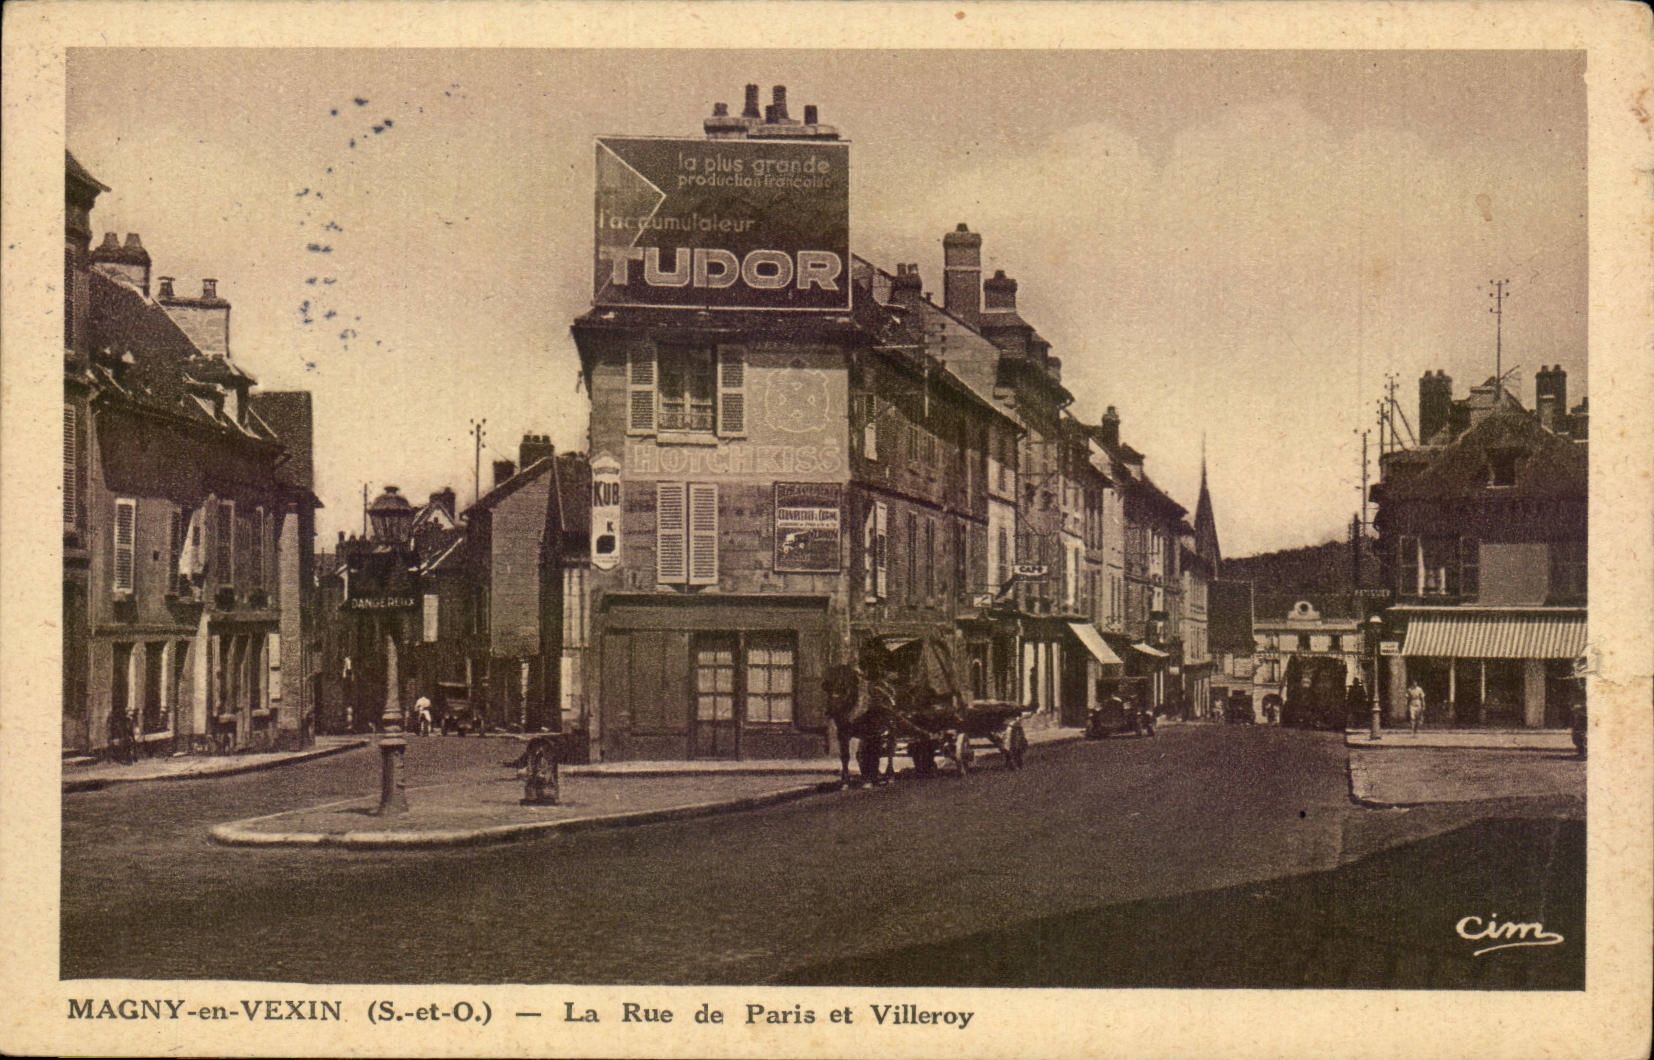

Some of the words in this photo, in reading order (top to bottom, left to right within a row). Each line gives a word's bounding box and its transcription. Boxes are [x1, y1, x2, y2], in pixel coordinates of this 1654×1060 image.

[678, 151, 697, 171] la
[705, 152, 743, 175] plus
[751, 154, 831, 176] grande
[678, 173, 762, 188] production
[598, 246, 843, 291] TUDOR
[634, 444, 842, 474] HOTCHKISS
[593, 480, 620, 507] KUB
[606, 520, 614, 533] K
[351, 596, 416, 609] DANGEREUX
